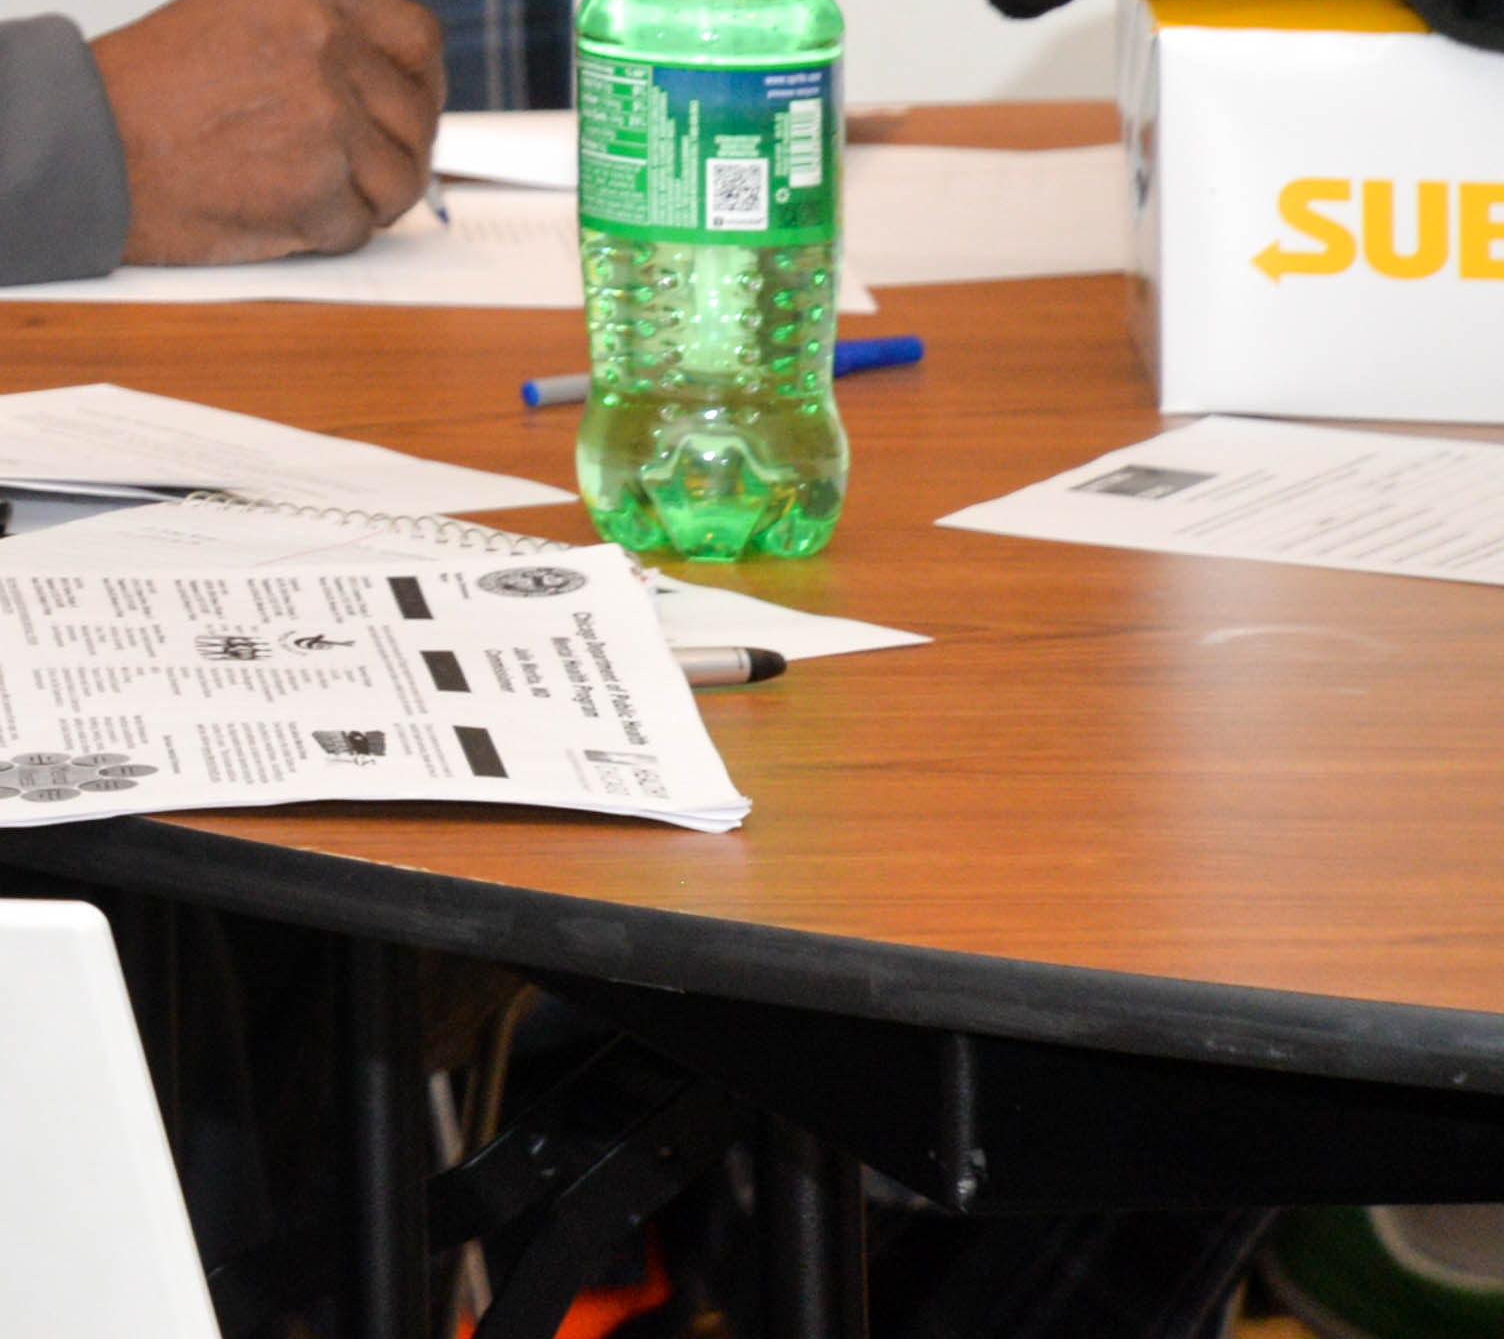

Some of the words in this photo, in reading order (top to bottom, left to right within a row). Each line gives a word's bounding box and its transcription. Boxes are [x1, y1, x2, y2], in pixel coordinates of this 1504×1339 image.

[572, 611, 598, 640] Chicago
[585, 640, 621, 682] Department
[620, 720, 649, 746] Health
